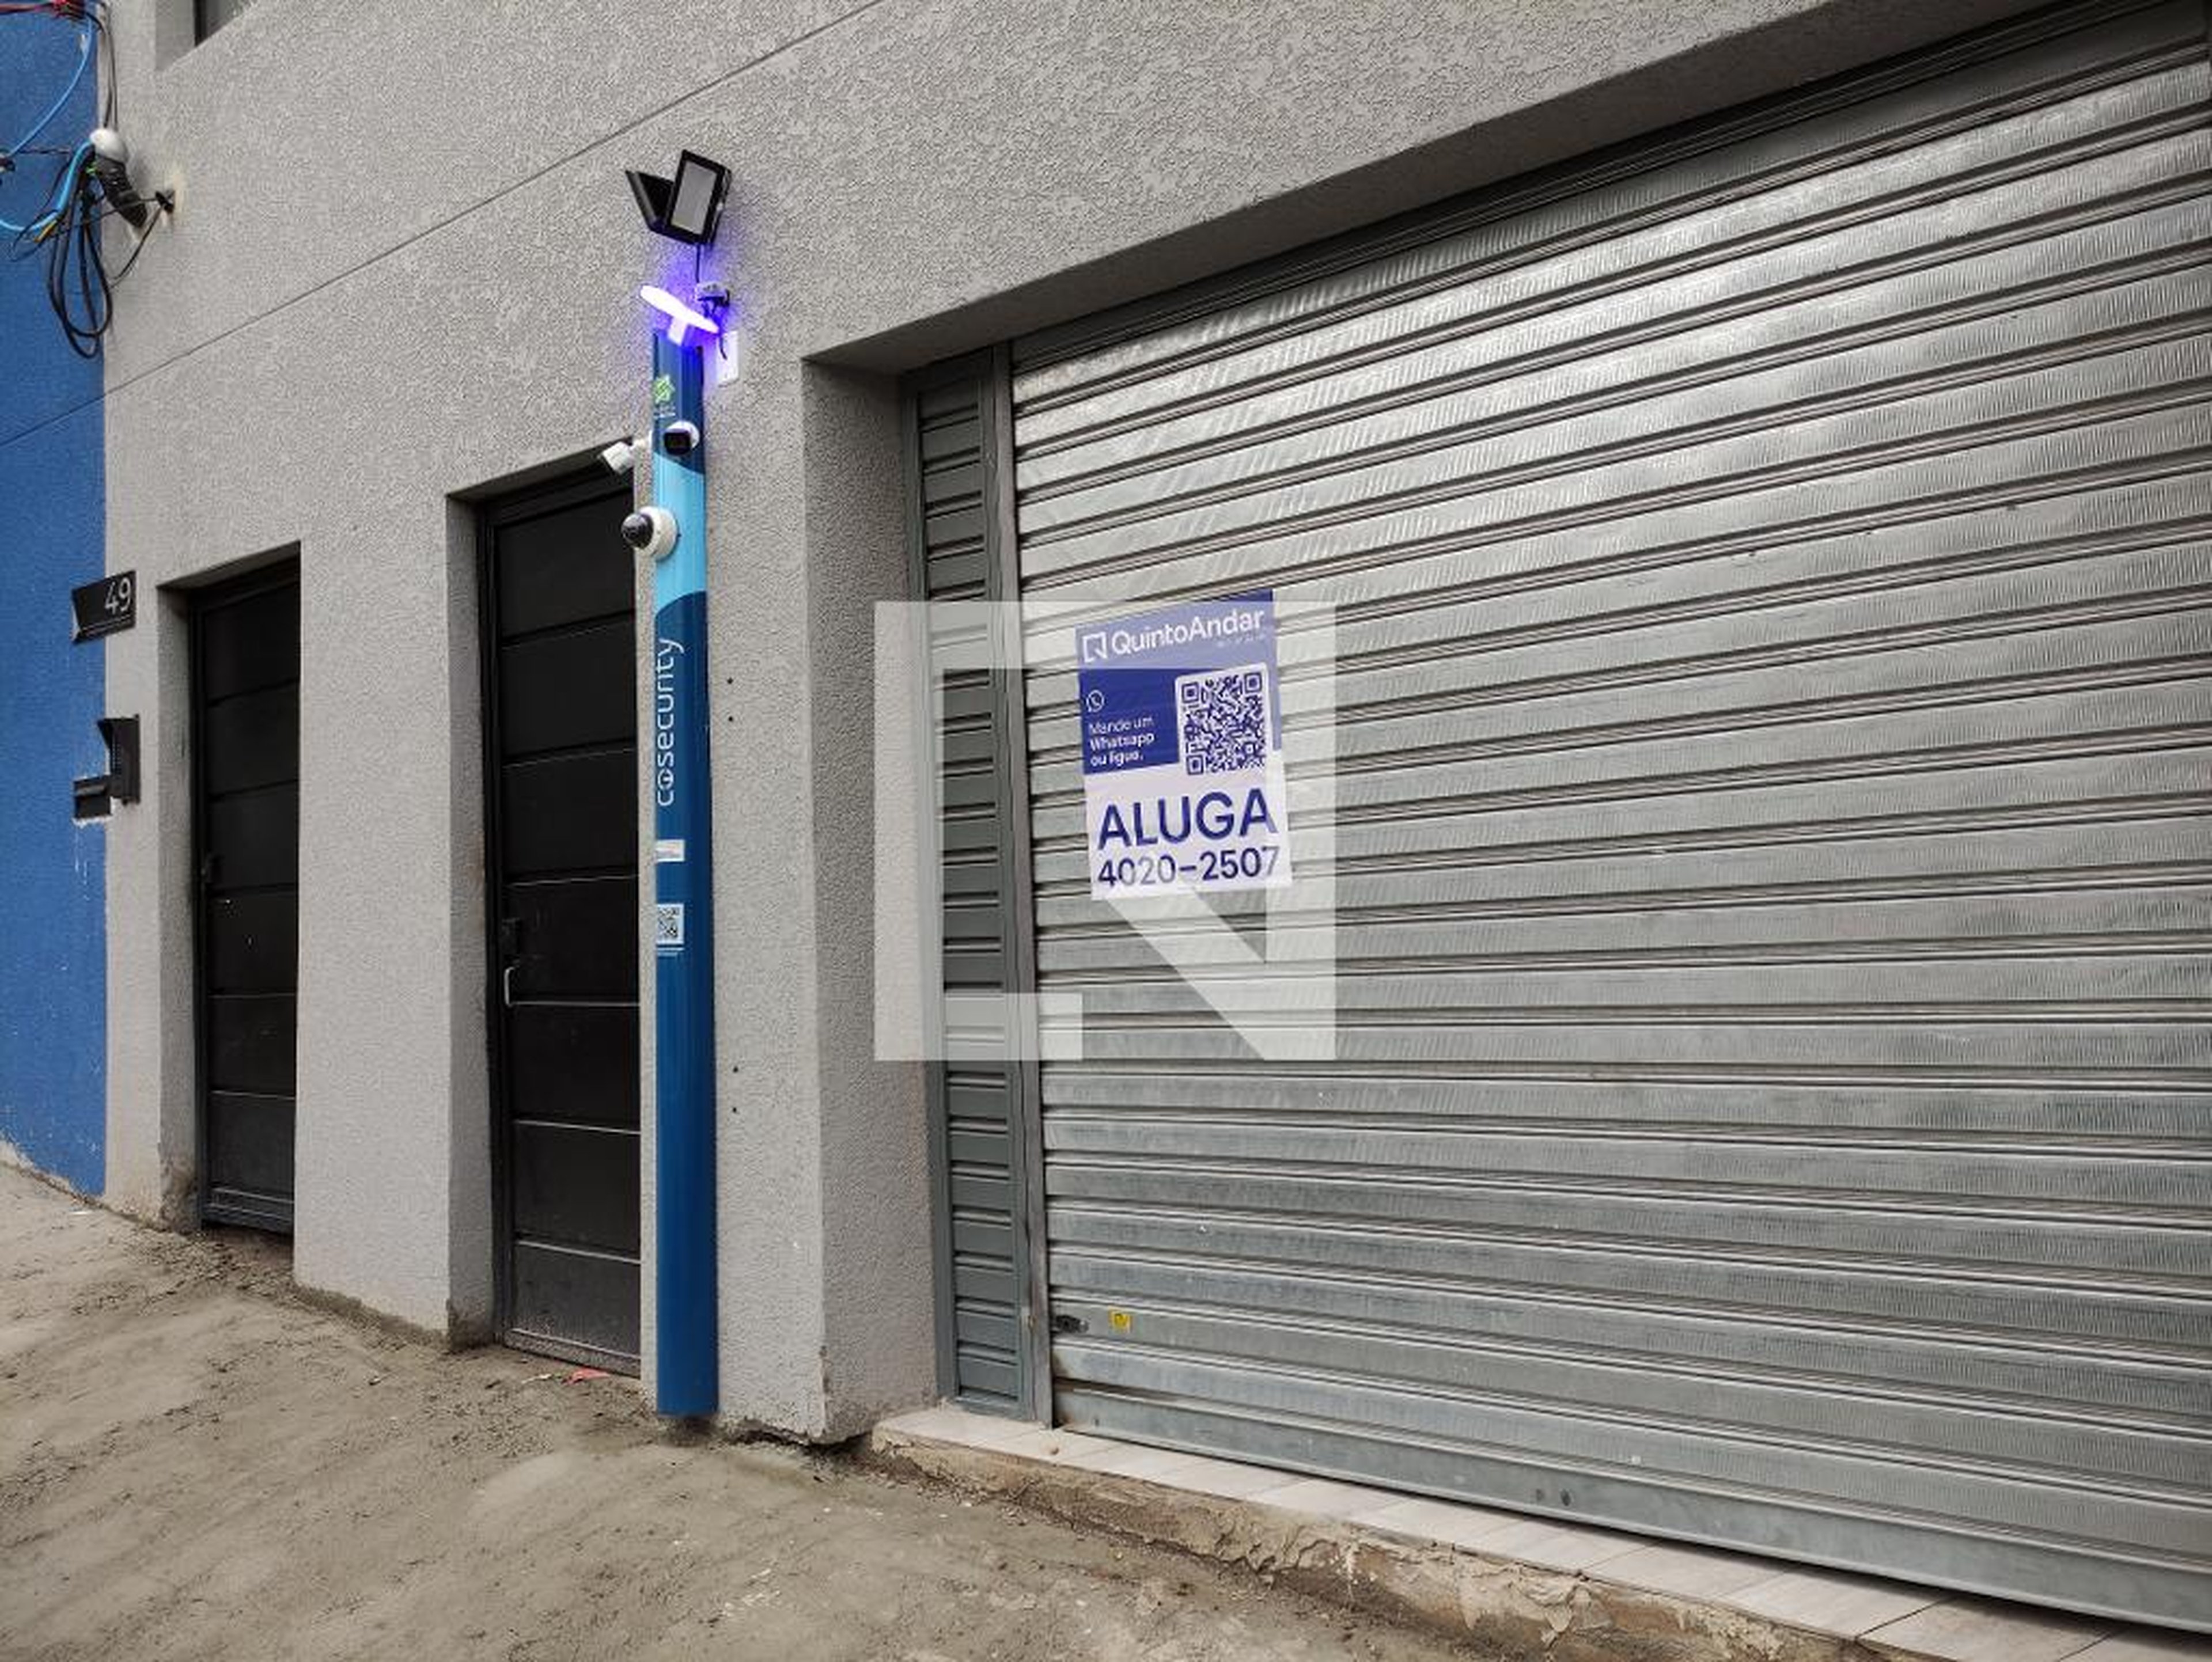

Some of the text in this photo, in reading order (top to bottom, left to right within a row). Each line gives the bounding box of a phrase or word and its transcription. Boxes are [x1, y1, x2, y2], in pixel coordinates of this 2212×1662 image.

[104, 577, 131, 614] 49
[1112, 609, 1264, 655] QuintoAndar
[656, 638, 685, 806] cosecurity
[1090, 755, 1107, 767] ou
[1098, 788, 1278, 850] ALUGA
[1098, 845, 1280, 887] 4020-2507
